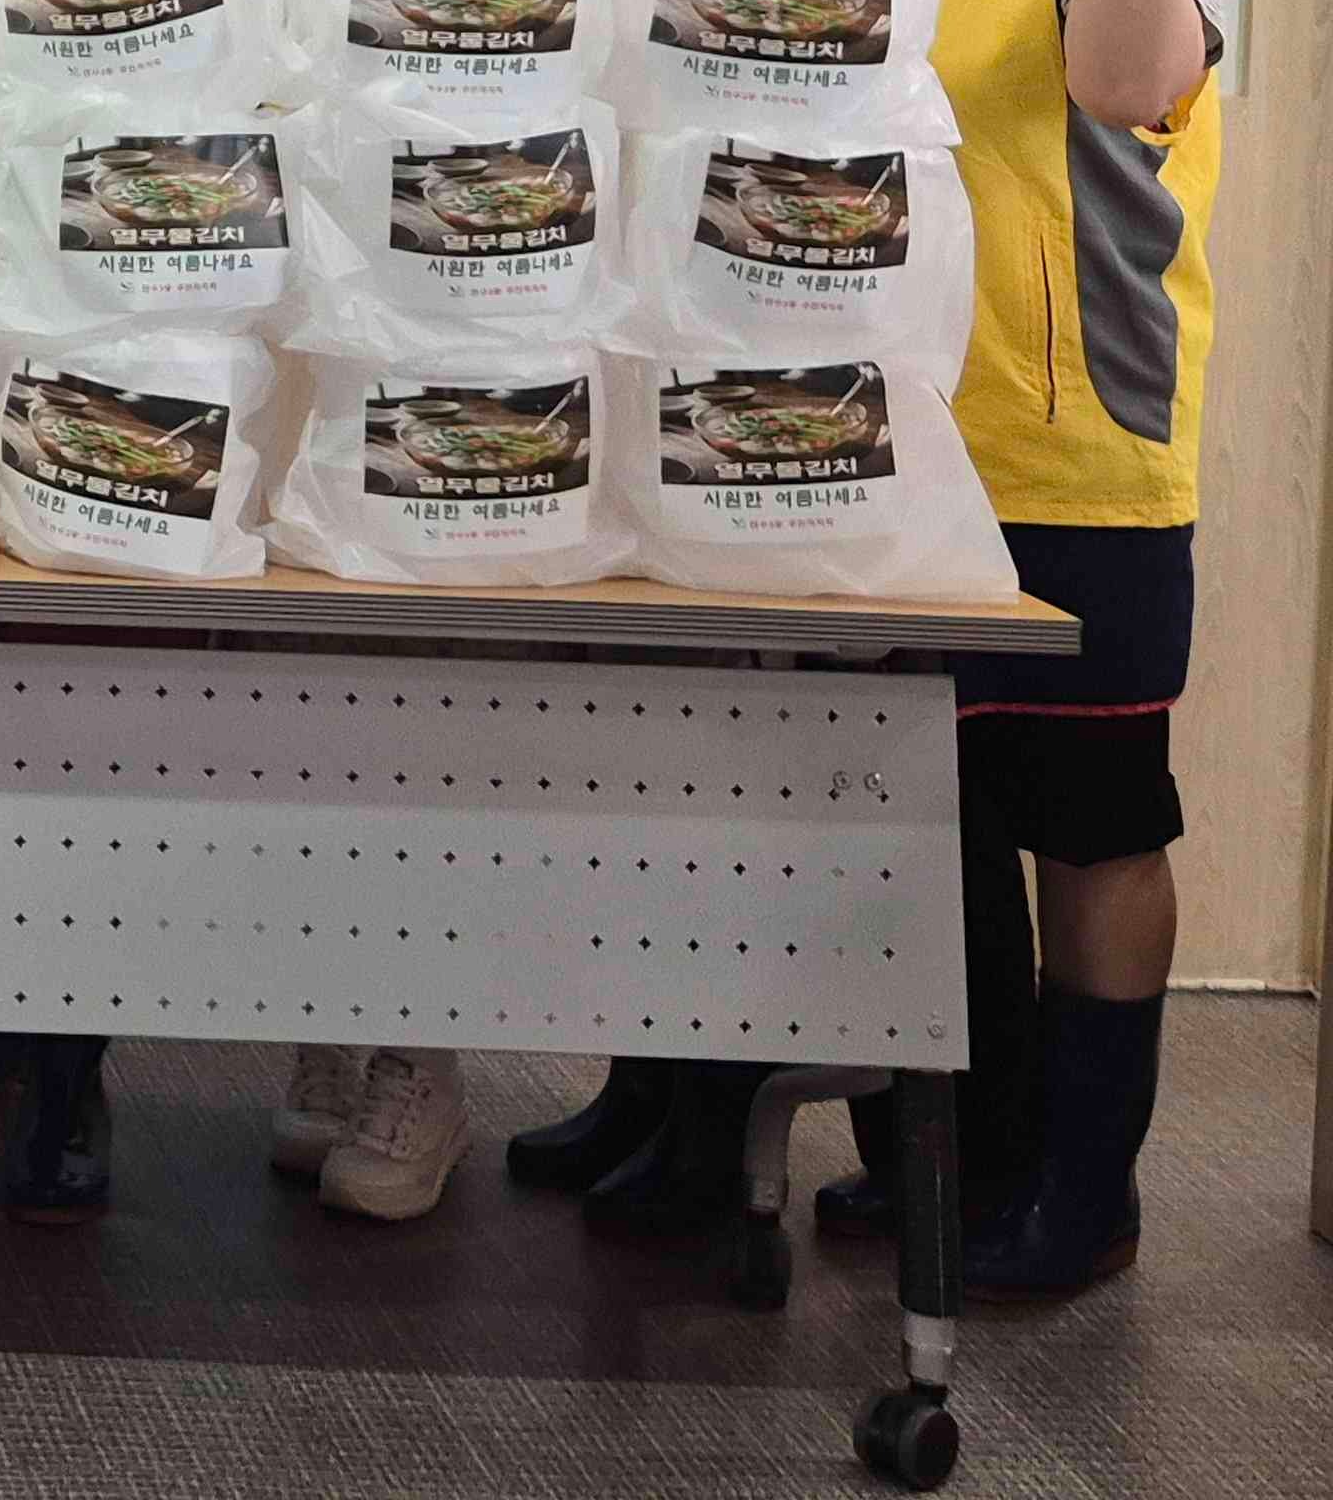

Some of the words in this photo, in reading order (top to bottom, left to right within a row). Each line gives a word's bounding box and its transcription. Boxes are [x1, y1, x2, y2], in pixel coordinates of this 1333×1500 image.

[43, 40, 93, 58] 시원한
[104, 23, 194, 56] 여름나세요
[385, 54, 442, 74] 시원한
[454, 57, 538, 75] 여름나세요
[683, 57, 740, 80] 시원한
[754, 64, 848, 87] 여름나세요
[99, 256, 154, 274] 시원한
[167, 253, 253, 272] 여름나세요
[427, 260, 484, 278] 시원한
[497, 251, 574, 276] 여름나세요
[726, 260, 784, 288] 시원한
[797, 274, 878, 292] 여름나세요
[23, 483, 66, 514] 시원한
[78, 504, 170, 536] 여름나세요
[403, 502, 460, 520] 시원한
[473, 498, 561, 520] 여름나세요
[703, 487, 762, 508] 시원한
[775, 485, 867, 508] 여름나세요
